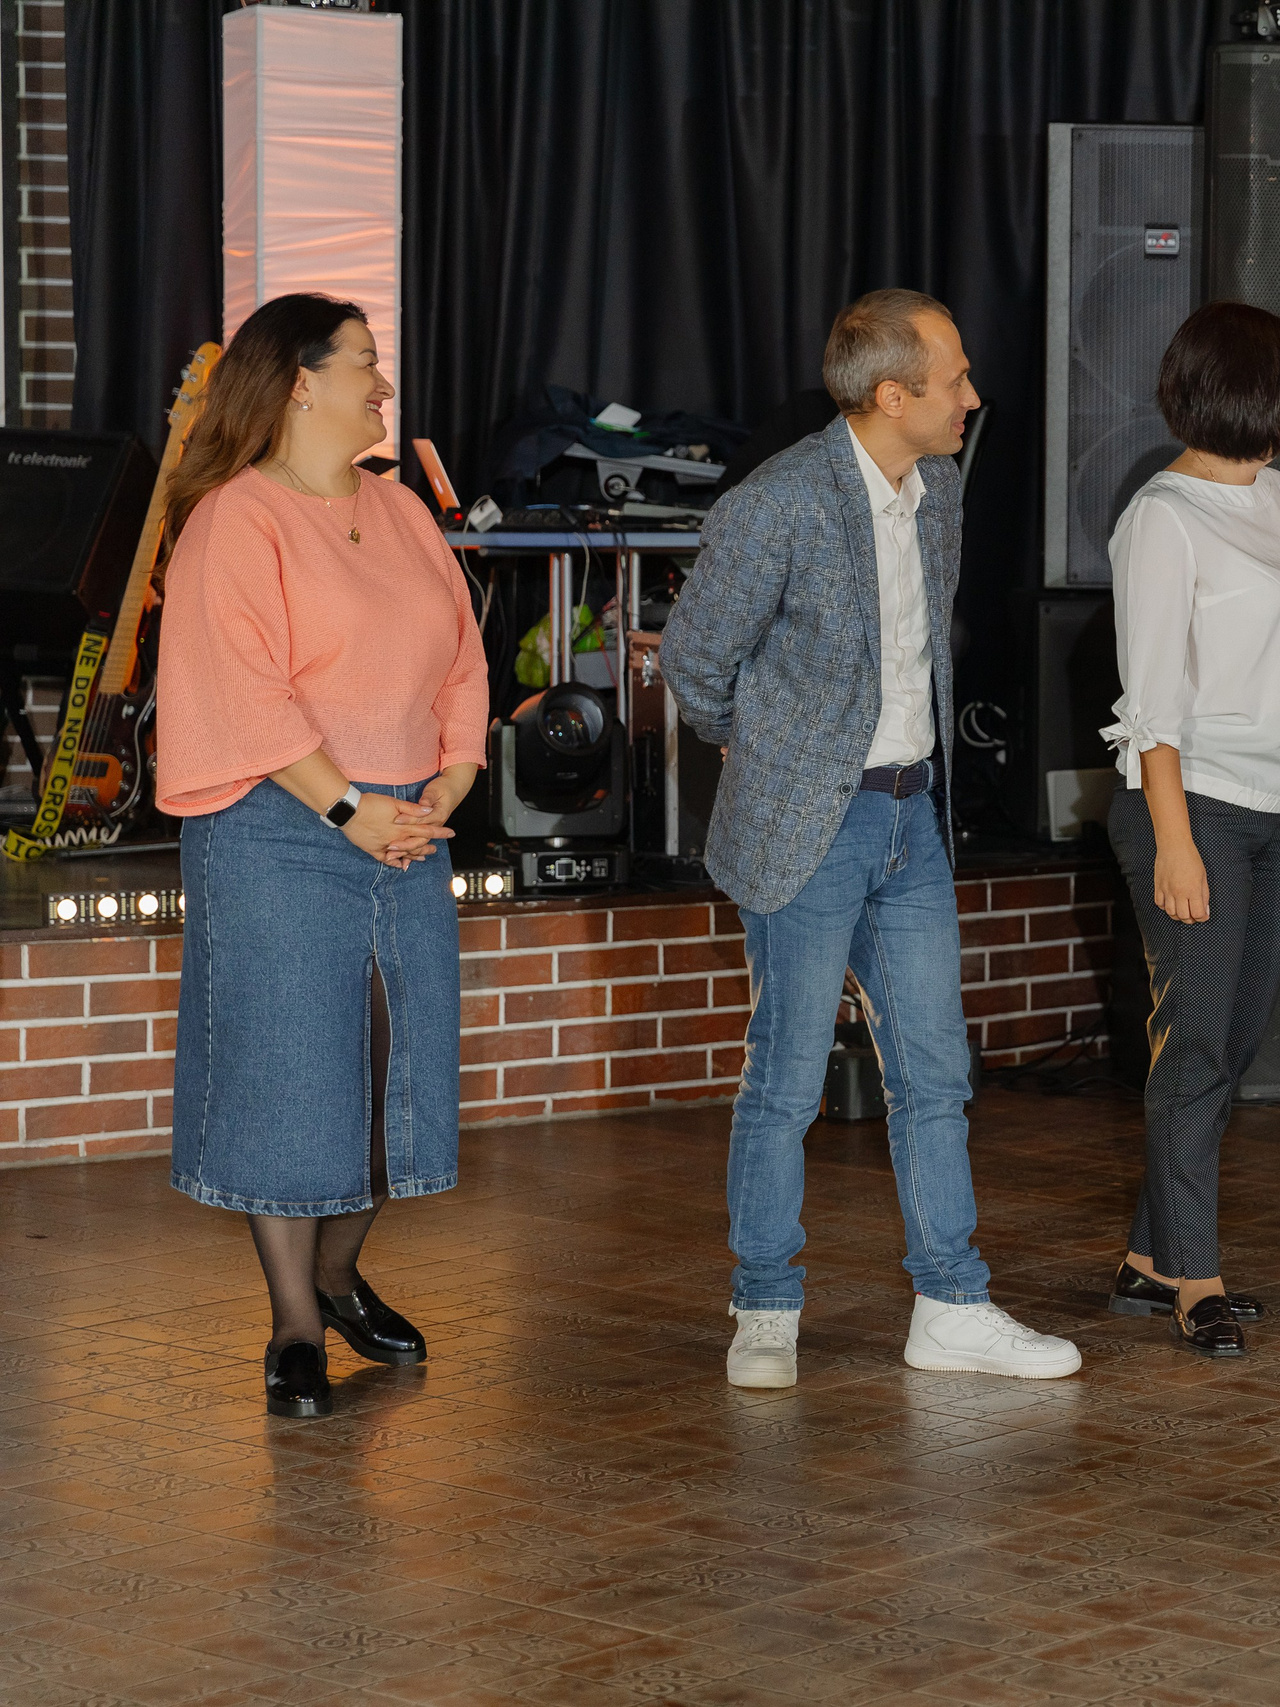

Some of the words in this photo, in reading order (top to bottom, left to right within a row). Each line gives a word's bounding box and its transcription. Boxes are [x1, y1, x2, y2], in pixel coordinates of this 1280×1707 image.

[23, 451, 87, 469] electronic
[72, 677, 91, 708] DO
[58, 718, 82, 767] NOT
